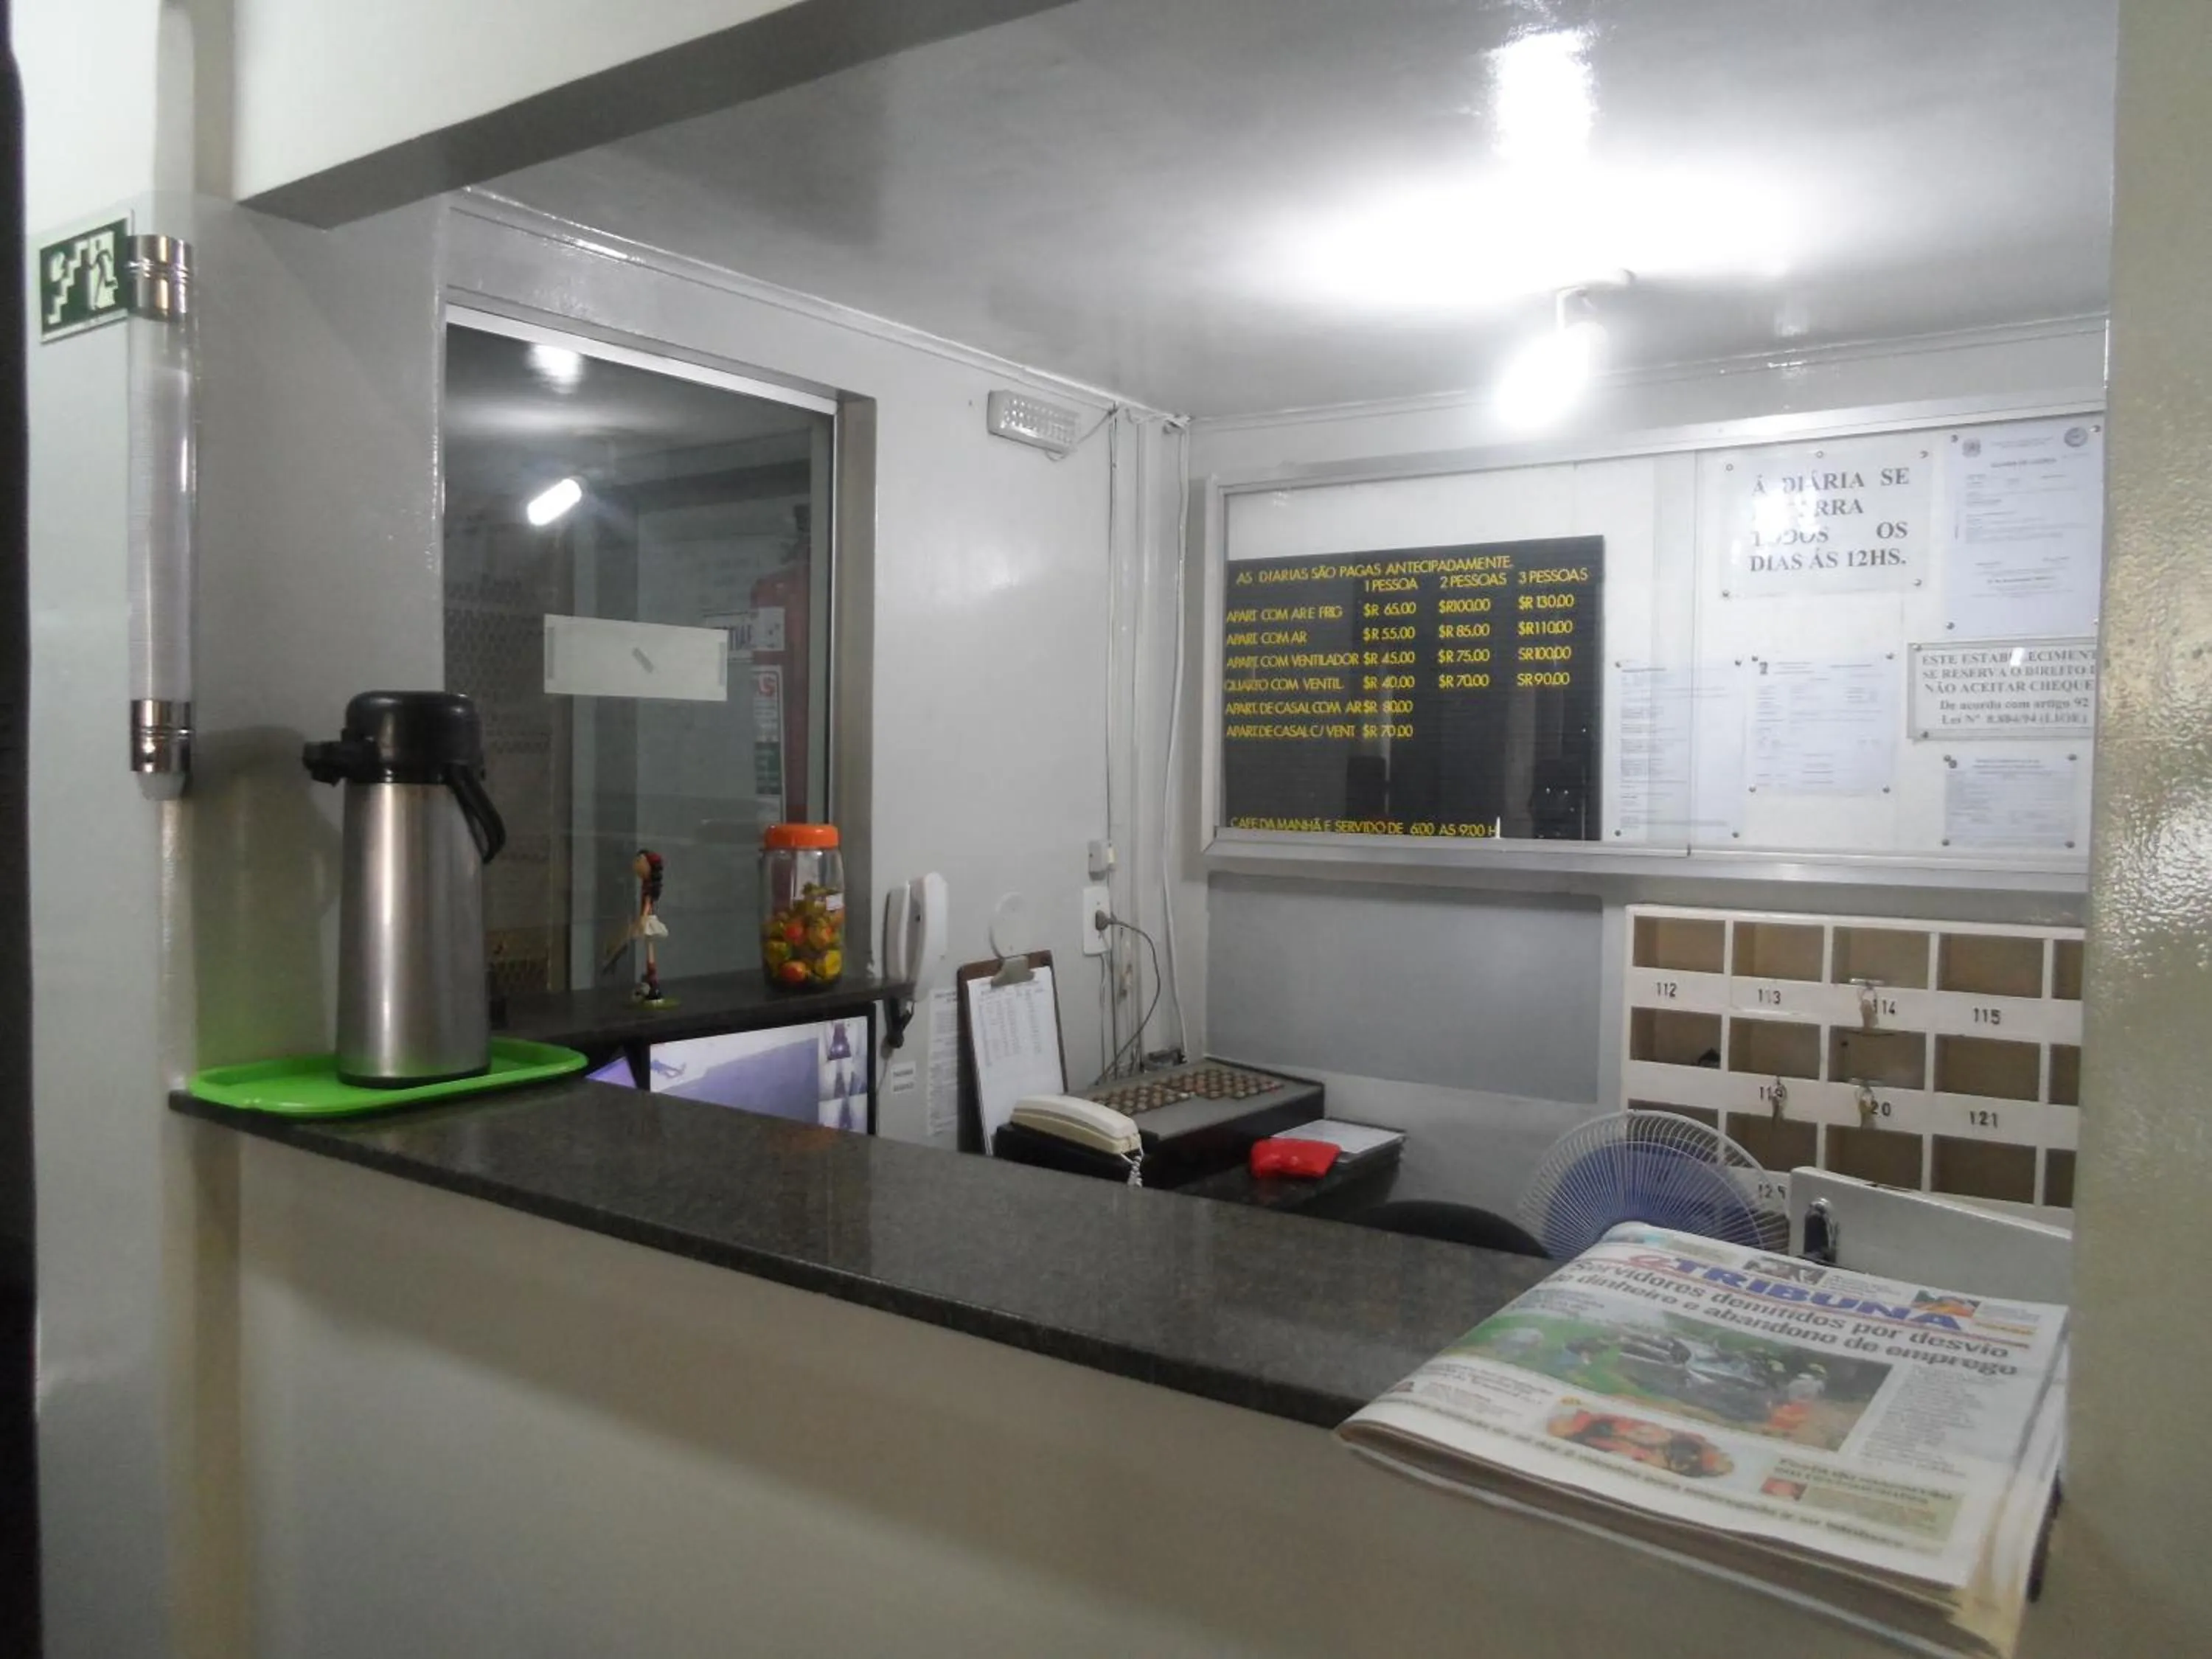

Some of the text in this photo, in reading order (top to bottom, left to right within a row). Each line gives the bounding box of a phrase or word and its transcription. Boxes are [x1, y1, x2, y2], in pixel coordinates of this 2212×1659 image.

[1880, 467, 1910, 487] SE
[1750, 521, 1908, 548] TDOS OS
[1750, 553, 1804, 572] DIAS
[1236, 572, 1253, 585] AS
[1311, 563, 1336, 580] SÃO
[1339, 563, 1381, 578] PAGAS
[1450, 572, 1508, 587] PESSOAS
[1528, 568, 1589, 583] PESSOAS
[1371, 577, 1419, 592] PESSOA
[1261, 608, 1287, 621] COM
[1261, 633, 1289, 644] COM
[1290, 630, 1309, 643] AR
[1260, 655, 1290, 667] COM
[1270, 678, 1299, 691] COM
[1960, 682, 2025, 693] ACEITAR
[2029, 679, 2096, 692] CHEQUE
[1657, 982, 1677, 998] 112
[1973, 1008, 2001, 1025] 115
[1969, 1110, 1998, 1129] 121
[1675, 1257, 1962, 1331] TRIBUNA
[1576, 1274, 1678, 1304] dinheiro
[1703, 1307, 1839, 1345] abandono
[1844, 1335, 1879, 1353] de
[1885, 1346, 2019, 1377] emprego
[1711, 1293, 1846, 1329] demitidos
[1851, 1323, 1905, 1340] por
[1909, 1329, 2010, 1359] desvio
